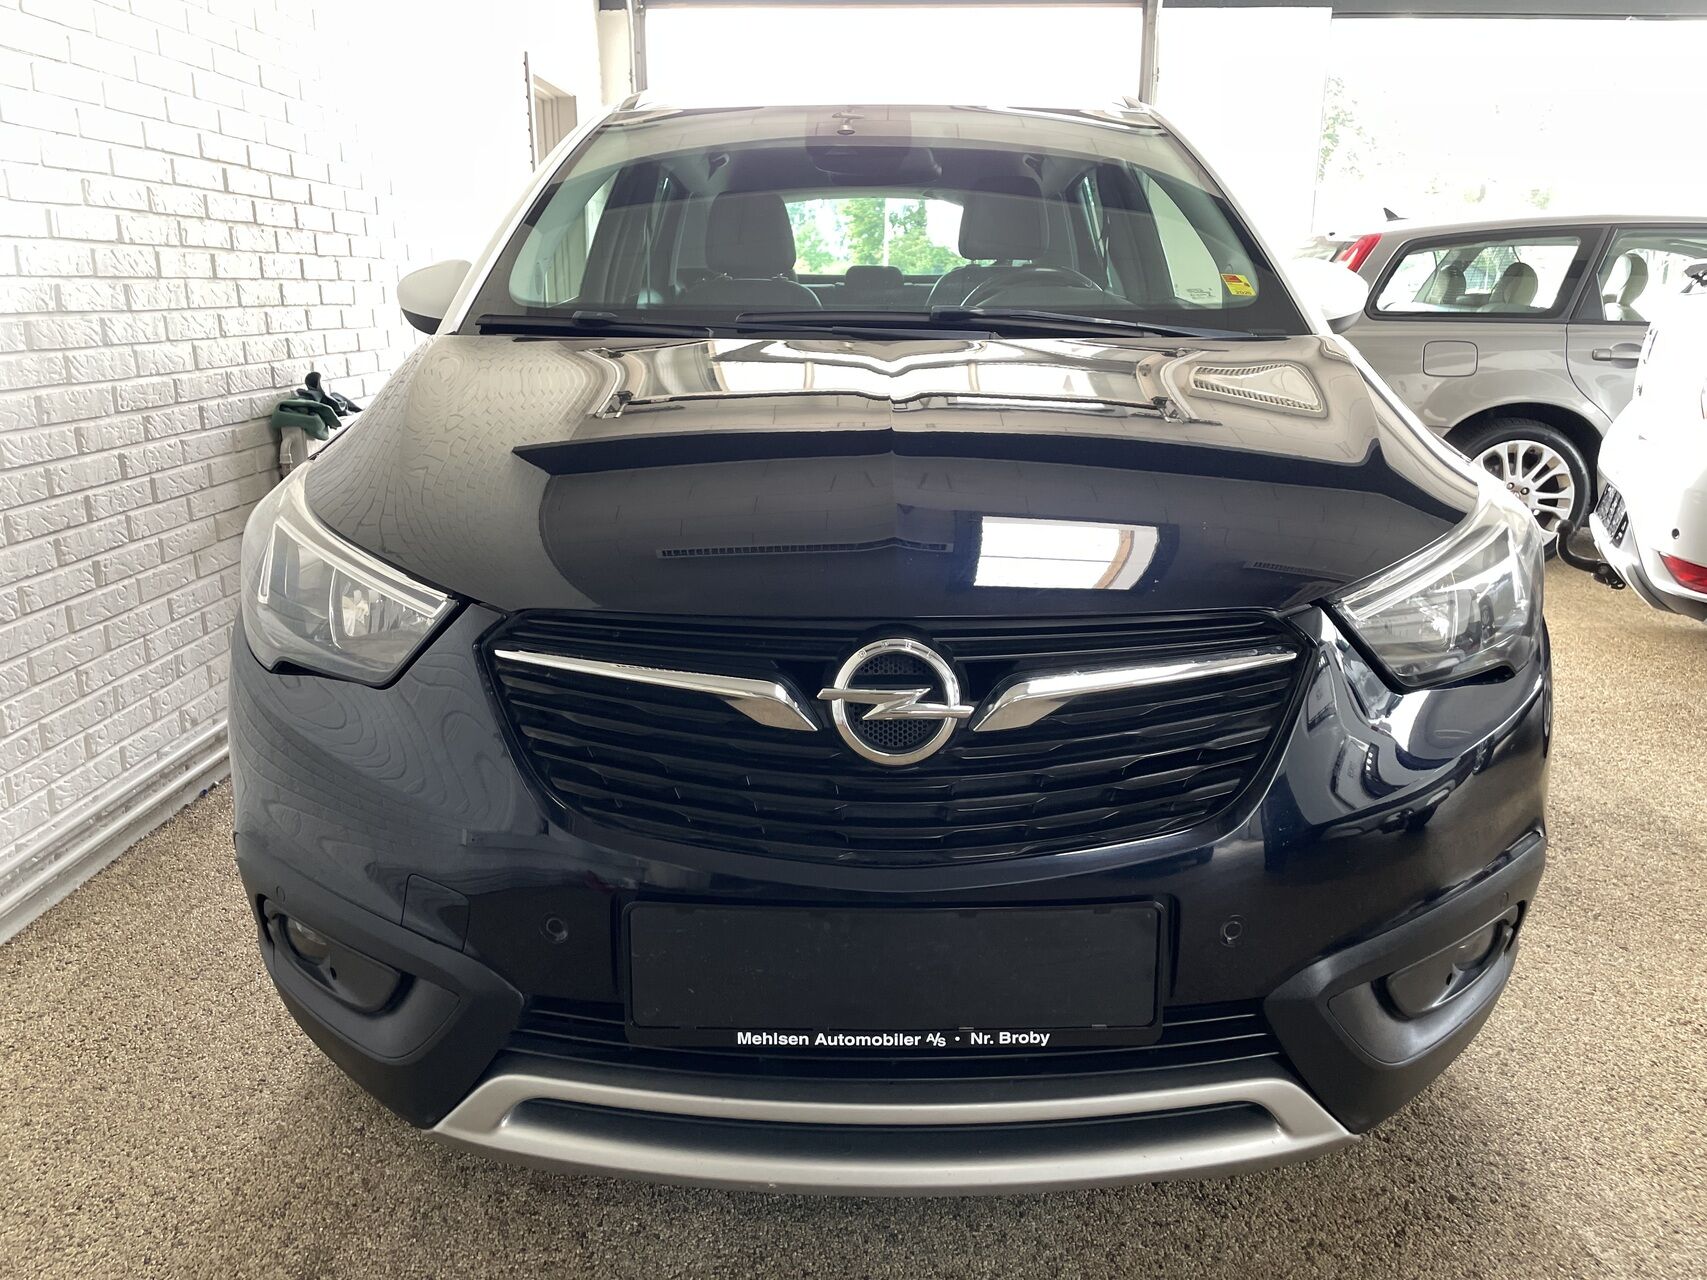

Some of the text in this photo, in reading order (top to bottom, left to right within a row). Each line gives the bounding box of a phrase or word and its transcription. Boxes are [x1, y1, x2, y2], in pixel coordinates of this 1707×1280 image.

[737, 1031, 1051, 1047] Mehlsen Automobiler A/S Nr. Broby
